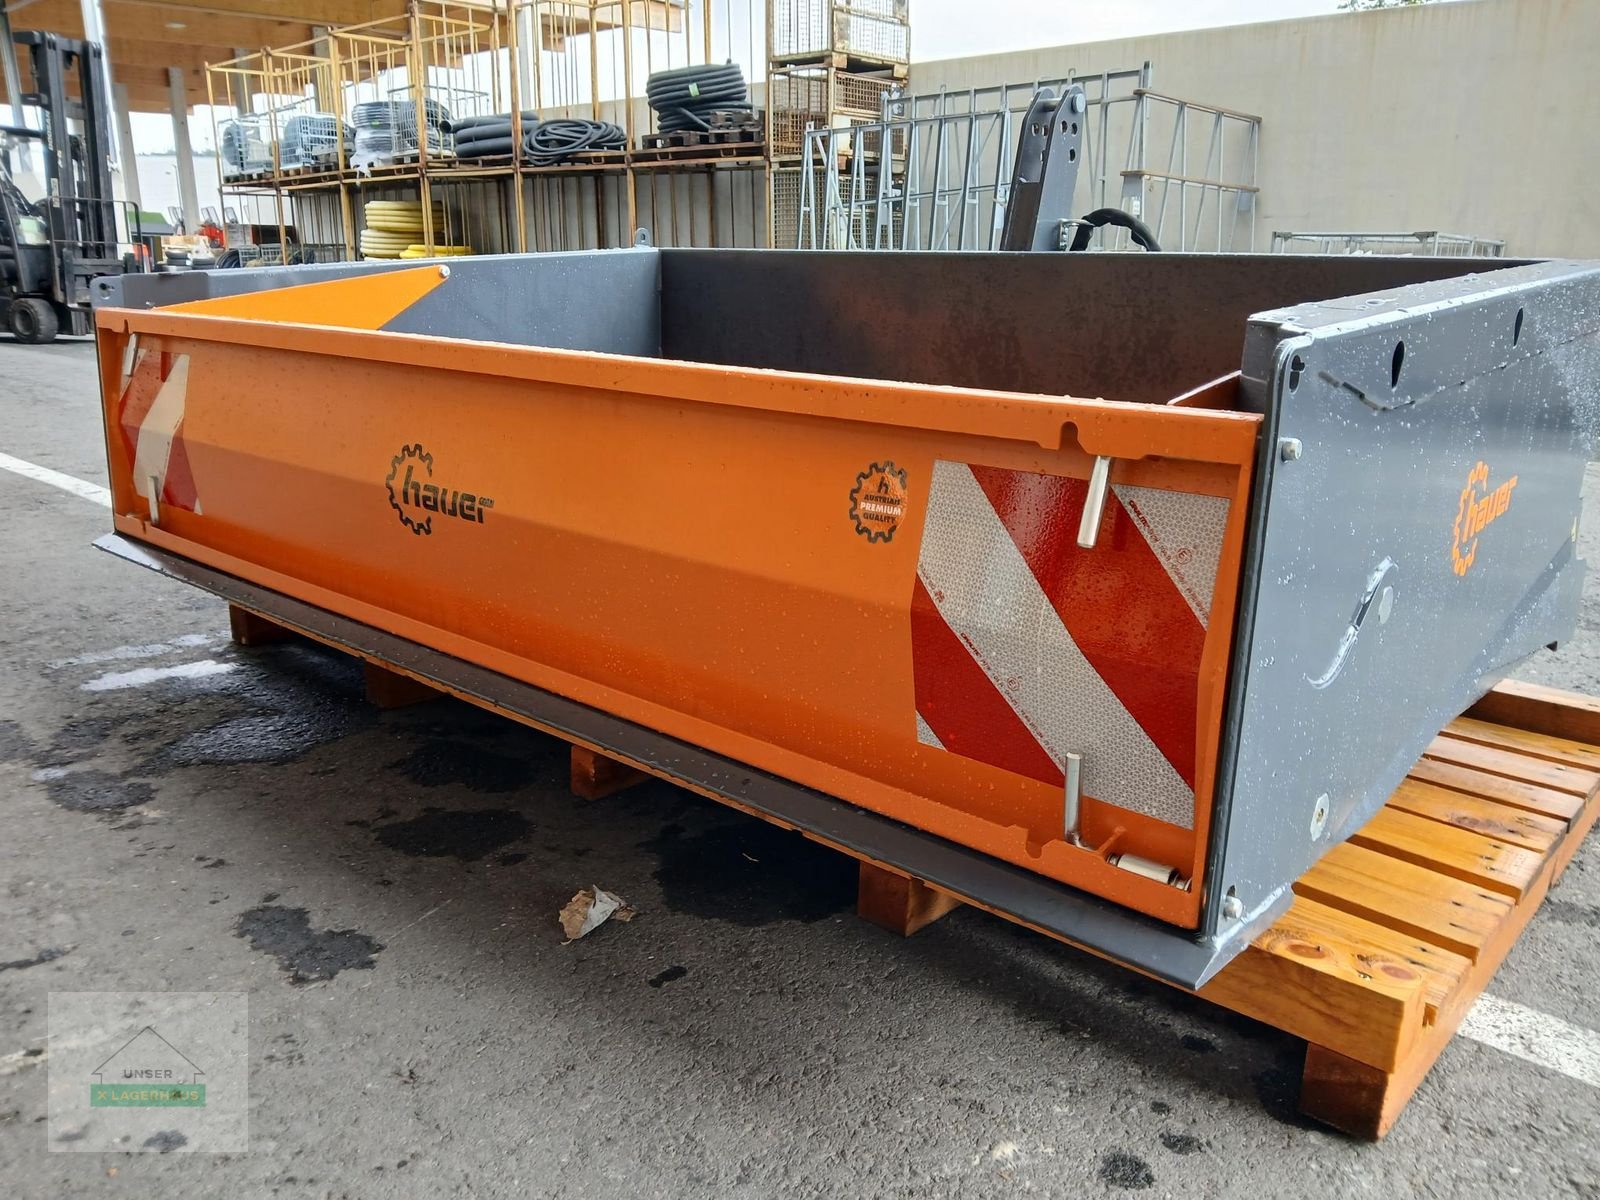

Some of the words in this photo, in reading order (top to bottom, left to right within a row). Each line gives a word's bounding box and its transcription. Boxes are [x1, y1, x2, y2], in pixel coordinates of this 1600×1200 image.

[864, 494, 900, 505] AUSTRIAN
[860, 502, 901, 515] PREMIUM
[1463, 475, 1518, 542] hauer
[863, 512, 896, 523] QUALITY
